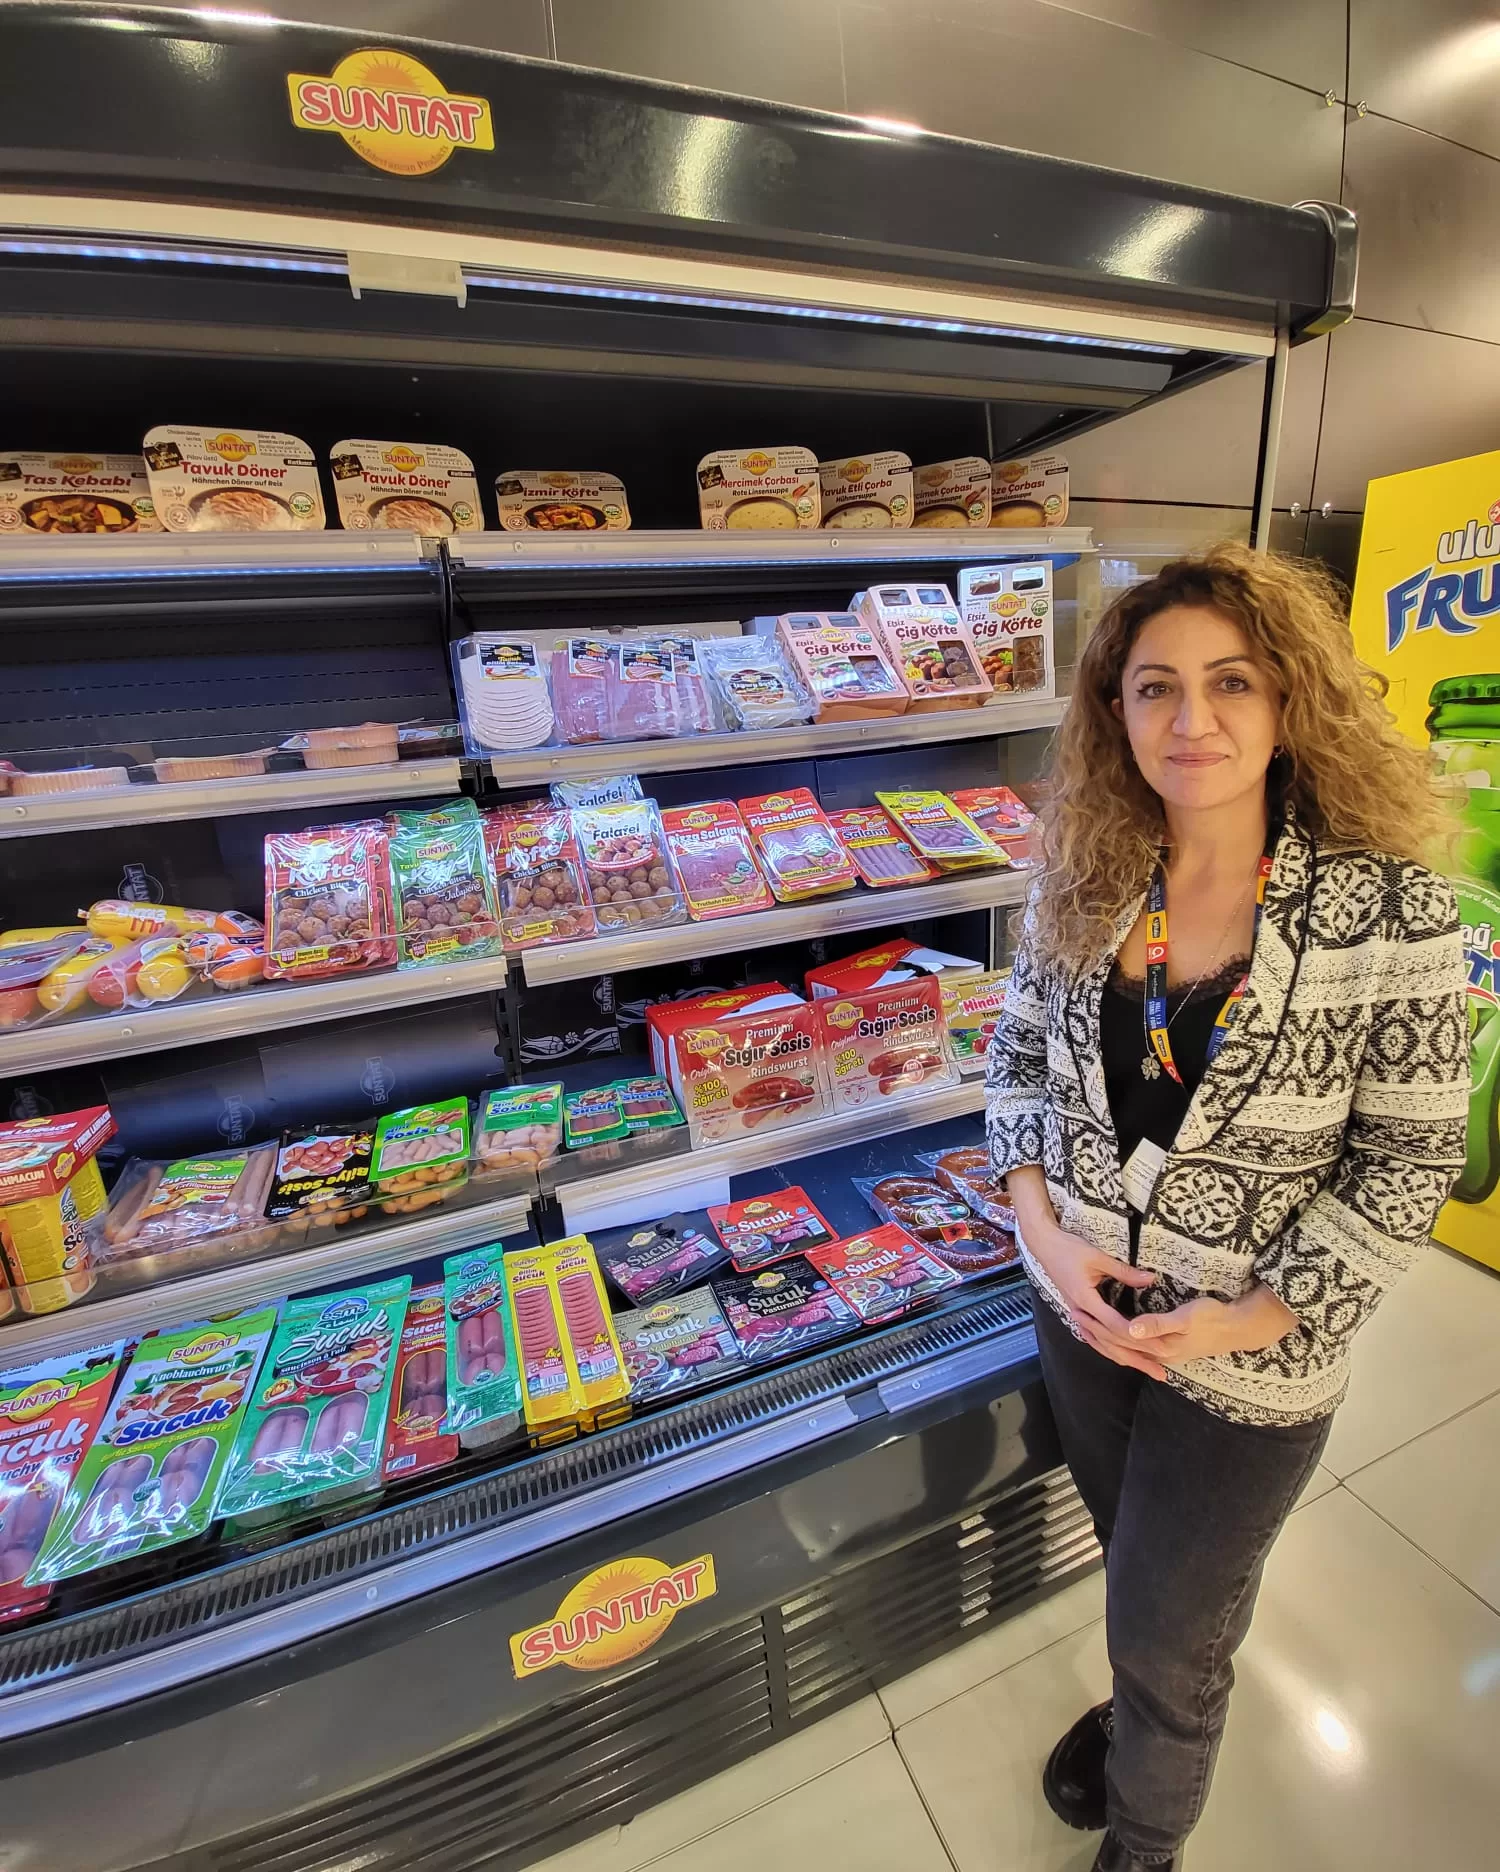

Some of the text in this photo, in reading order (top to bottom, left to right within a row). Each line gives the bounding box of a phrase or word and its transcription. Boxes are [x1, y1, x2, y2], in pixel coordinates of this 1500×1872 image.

[299, 81, 485, 143] SUNTAT
[208, 442, 252, 453] SUNTAT
[384, 454, 422, 465] SUNTAT
[741, 460, 773, 469] SUNTAT
[180, 461, 288, 478] Tavuk Döner
[23, 474, 132, 488] Tas Kebabı
[192, 477, 231, 485] Hähnchen
[231, 478, 253, 486] Döner
[255, 479, 267, 487] auf
[360, 471, 451, 488] Tavuk Döner
[720, 476, 799, 489] Mercimek Çorbası
[848, 482, 863, 493] Etli
[864, 479, 892, 492] Çorba
[1008, 480, 1045, 494] Çorbası
[370, 485, 402, 494] Hähnchen
[403, 486, 422, 495] Döner
[424, 488, 434, 496] auf
[562, 487, 599, 498] Köfte
[732, 487, 789, 497] Rote Linsensuppe
[914, 484, 972, 499] cimek Çorbası
[991, 600, 1024, 611] SUNTAT
[1386, 564, 1500, 656] FRU
[967, 612, 986, 621] Etsiz
[895, 624, 958, 640] Çiğ Köfte
[972, 617, 1043, 639] Çiğ Köfte
[804, 642, 872, 656] Çiğ Köfte
[578, 786, 623, 806] Falafel
[762, 799, 793, 810] SUNTAT
[683, 814, 716, 826] SUNTAT
[750, 814, 781, 828] Pizza
[903, 809, 947, 820] Salami
[592, 823, 640, 841] Falafel
[843, 826, 889, 840] Salami
[418, 843, 455, 858] SUNTAT
[399, 862, 421, 870] Tavu
[513, 867, 540, 879] Chicken
[295, 885, 328, 898] Chicken
[1460, 922, 1492, 951] ağ
[975, 980, 1007, 994] Premiu
[877, 997, 920, 1013] Premium
[962, 994, 998, 1013] Hindi
[828, 1008, 862, 1024] SUNTAT
[859, 1005, 937, 1038] Sığır Sosis
[981, 1010, 1003, 1019] Truth
[746, 1022, 794, 1040] Premium
[883, 1028, 936, 1049] Rindswurst
[690, 1037, 727, 1051] SUNTAT
[724, 1032, 812, 1069] Sığır Sosis
[834, 1049, 857, 1066] %100
[751, 1055, 809, 1079] Rindswurst
[834, 1056, 865, 1077] Sığır eti
[369, 1059, 386, 1102] SUNTAT
[694, 1078, 721, 1095] %100
[623, 1090, 665, 1100] Sucuk
[693, 1086, 730, 1109] Sığır eti
[490, 1103, 532, 1116] Sosis
[571, 1101, 616, 1116] Sucuk
[228, 1101, 243, 1142] SUNTAT
[384, 1126, 431, 1142] Sosis
[0, 1170, 45, 1186] AHMACUN
[277, 1179, 325, 1196] Sosis
[737, 1210, 794, 1232] Sucuk
[627, 1237, 682, 1266] Sucuk
[641, 1247, 680, 1267] Pastırmalı
[555, 1259, 588, 1272] Sucuk
[844, 1249, 902, 1277] Sucuk
[452, 1269, 498, 1298] Sucuk
[512, 1270, 545, 1284] Sucuk
[748, 1283, 812, 1312] Sucuk
[412, 1301, 443, 1312] SUNTA
[762, 1298, 806, 1315] Pastırmalı
[277, 1308, 388, 1365] Sucuk
[402, 1321, 446, 1339] Sucu
[635, 1317, 704, 1348] Sucuk
[173, 1336, 237, 1359] SUNTAT
[150, 1360, 238, 1385] Knoblauchwurst
[0, 1384, 74, 1413] SUNTAT
[113, 1397, 233, 1447] Sucuk
[521, 1562, 707, 1668] SUNTAT
